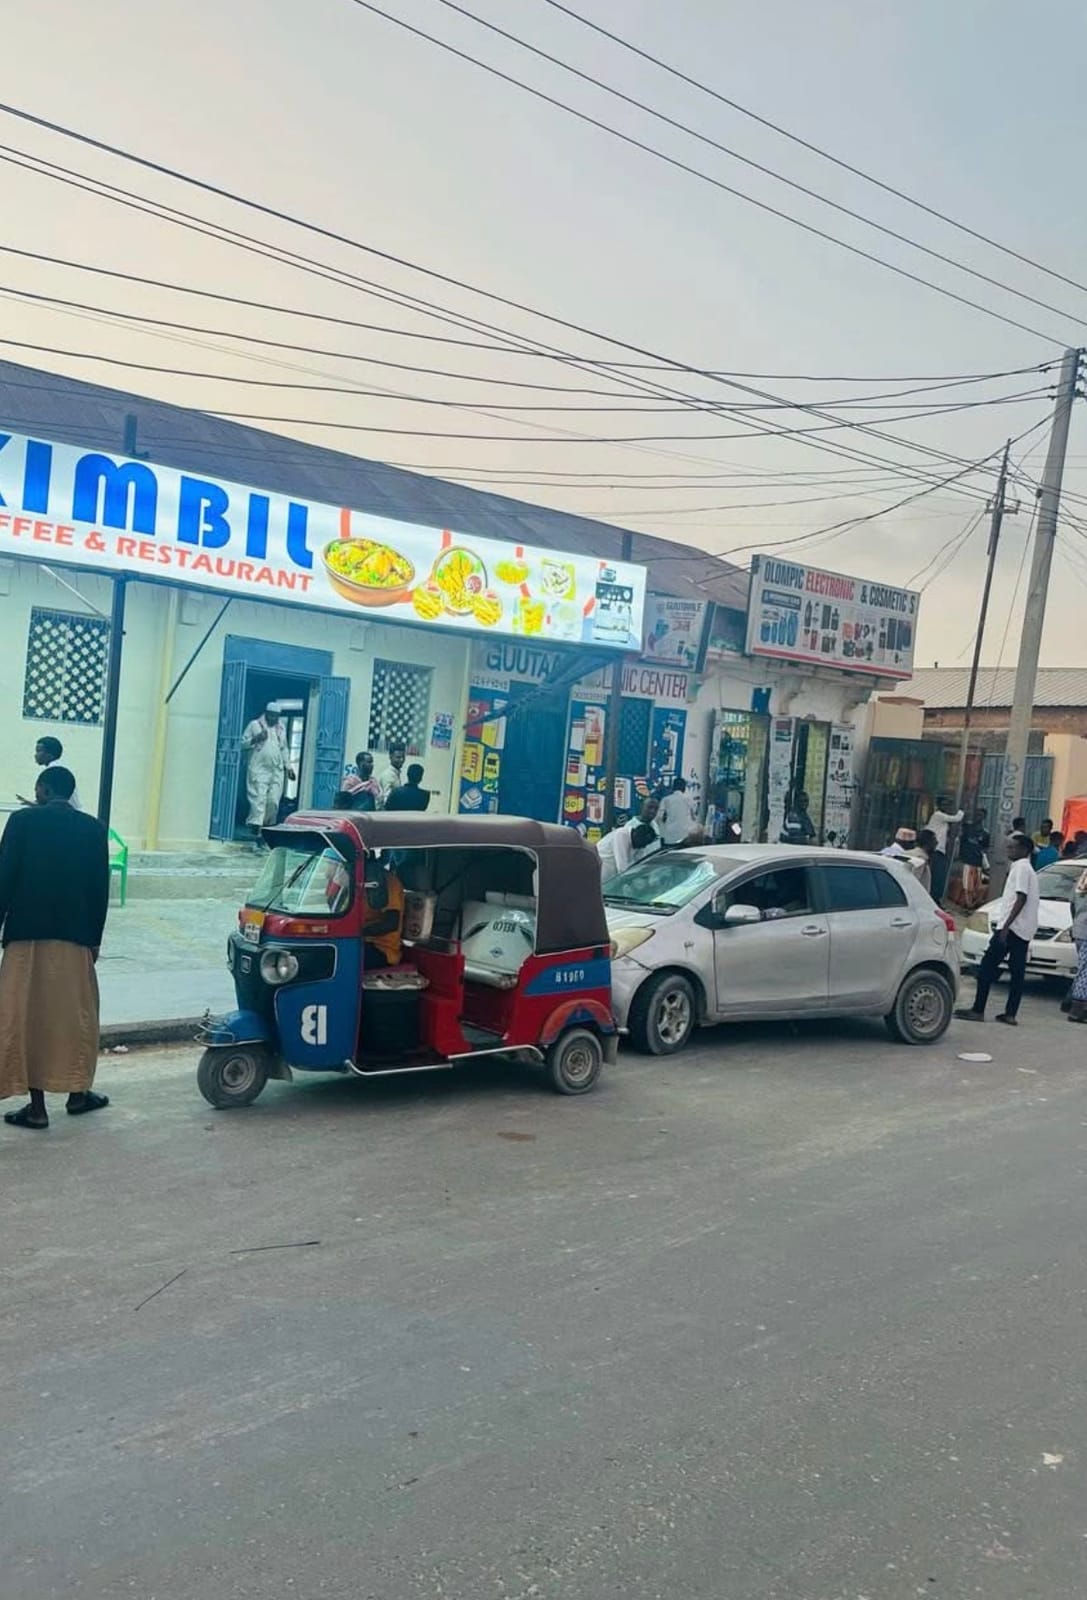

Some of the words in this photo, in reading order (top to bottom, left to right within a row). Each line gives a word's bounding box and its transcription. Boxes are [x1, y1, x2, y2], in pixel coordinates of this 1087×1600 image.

[0, 434, 313, 569] IMBIL
[84, 531, 106, 552] &
[116, 536, 313, 592] RESTAURANT
[805, 571, 855, 600] ELECTRONIC
[861, 585, 867, 604] &
[640, 669, 687, 698] CENTER
